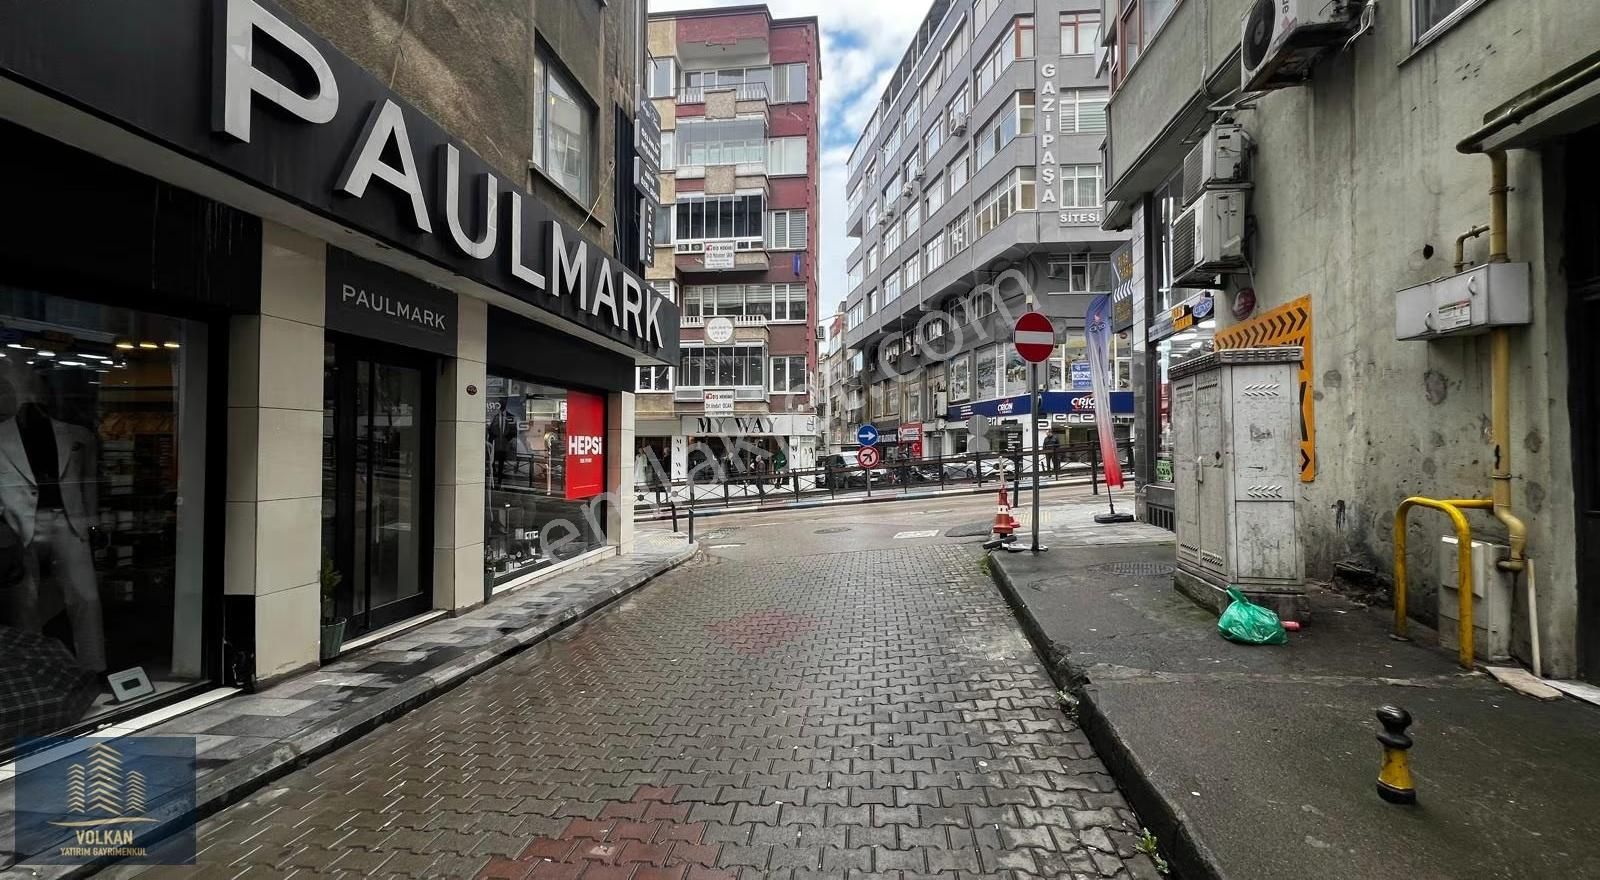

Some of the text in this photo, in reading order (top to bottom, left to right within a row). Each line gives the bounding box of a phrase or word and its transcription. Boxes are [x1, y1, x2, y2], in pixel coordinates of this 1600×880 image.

[1041, 63, 1056, 203] GAZİPAŞA
[213, 0, 665, 349] PAULMARK
[1060, 212, 1100, 224] SİTESİ
[342, 284, 446, 331] PAULMARK
[697, 416, 778, 433] MY WAY
